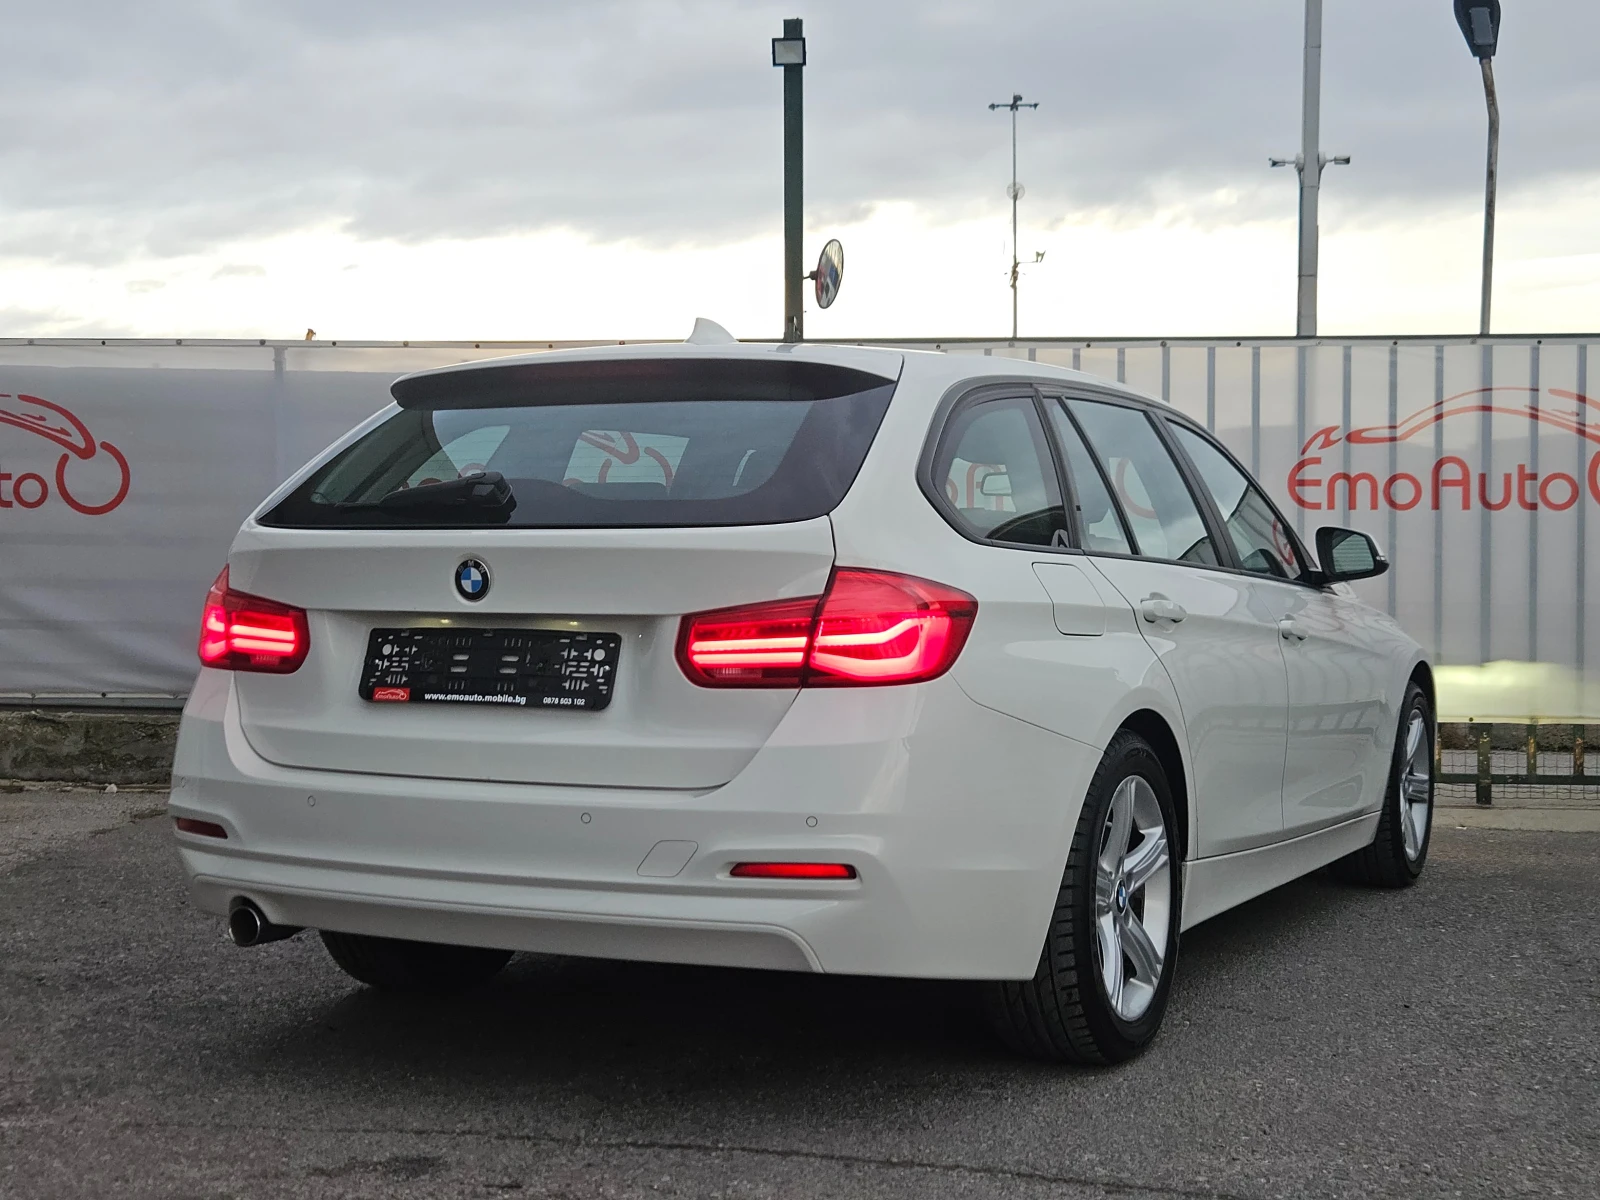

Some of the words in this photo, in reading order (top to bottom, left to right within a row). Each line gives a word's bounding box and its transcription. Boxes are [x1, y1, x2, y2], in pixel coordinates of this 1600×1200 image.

[1287, 456, 1579, 511] EmoAuto
[424, 693, 526, 705] www.emoauto.mobile.bg
[574, 698, 586, 706] 102
